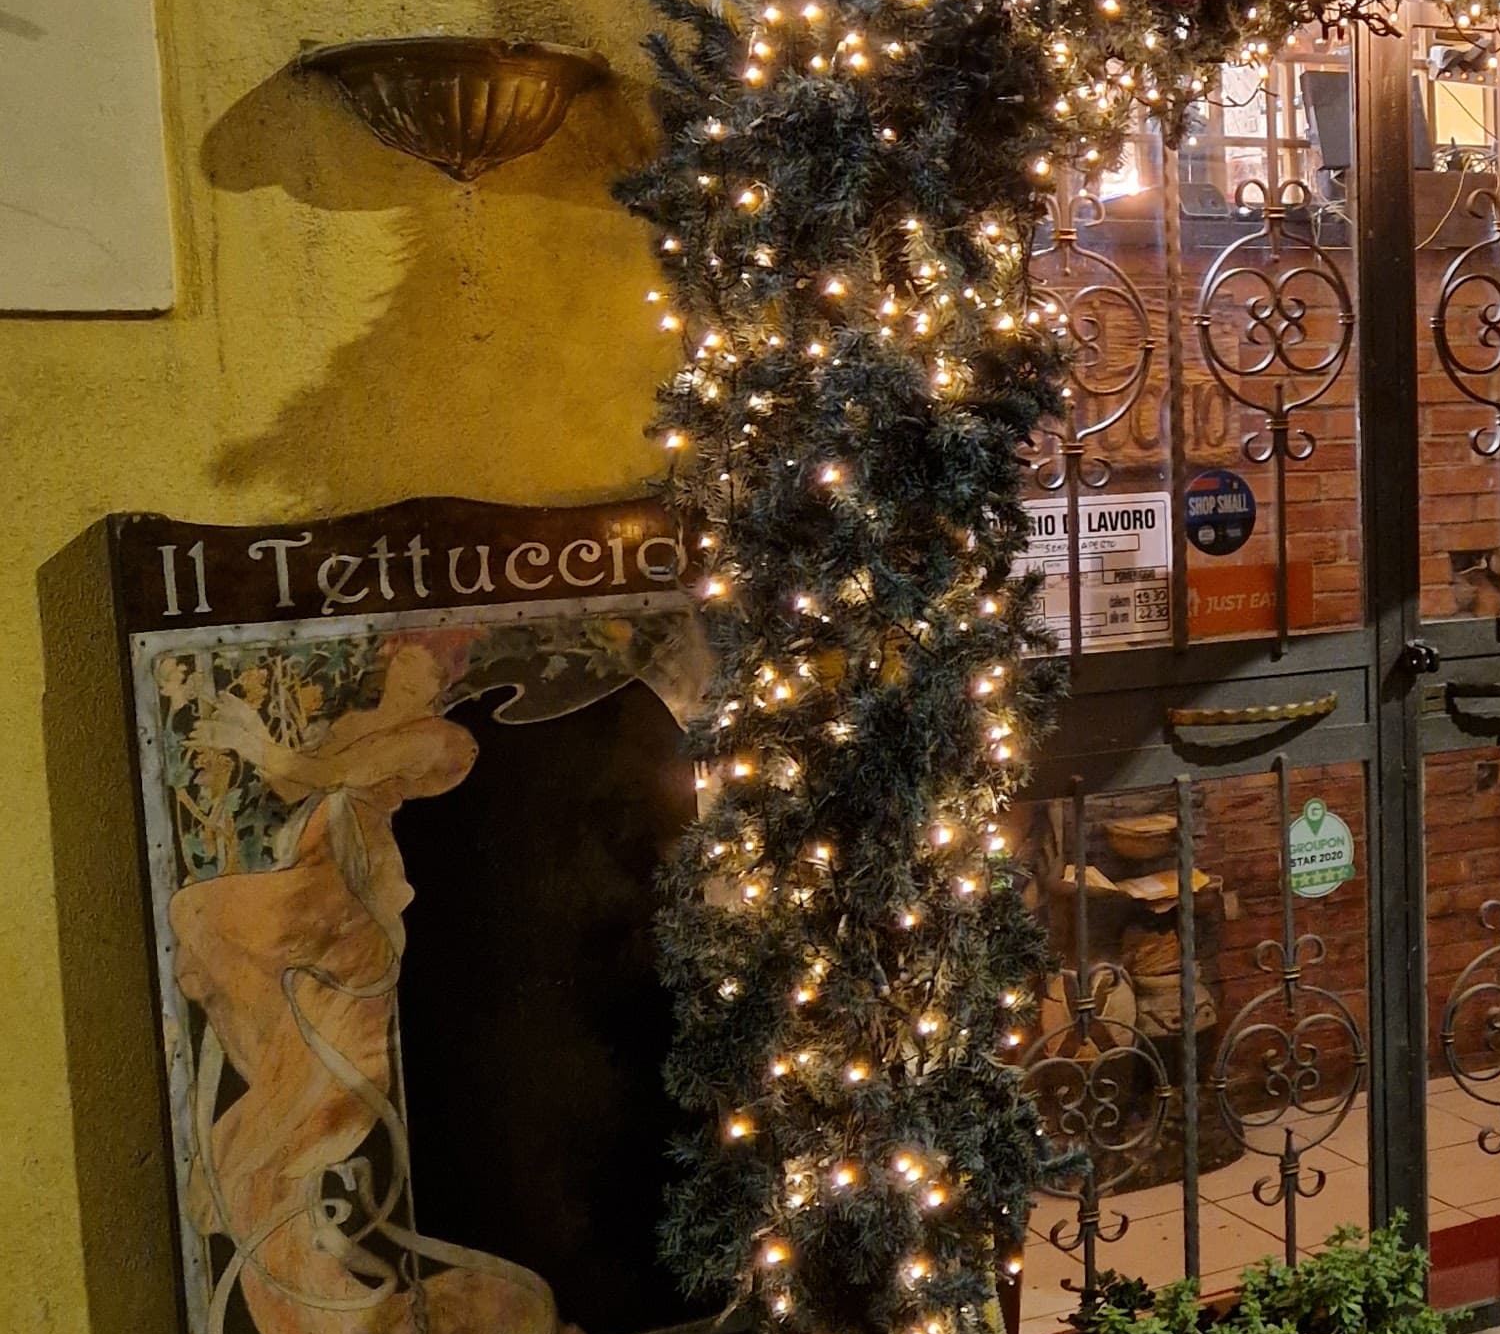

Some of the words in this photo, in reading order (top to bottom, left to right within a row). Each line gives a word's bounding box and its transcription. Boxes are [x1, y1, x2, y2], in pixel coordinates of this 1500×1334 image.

[1188, 496, 1214, 517] SHOP
[1217, 493, 1249, 514] SMALL
[1088, 508, 1155, 533] LAVORO
[156, 541, 214, 617] Il
[246, 531, 688, 617] Tettuccio
[1206, 593, 1247, 614] JUST
[1250, 591, 1277, 609] EA
[1290, 855, 1317, 868] STAR
[1319, 850, 1343, 863] 2020
